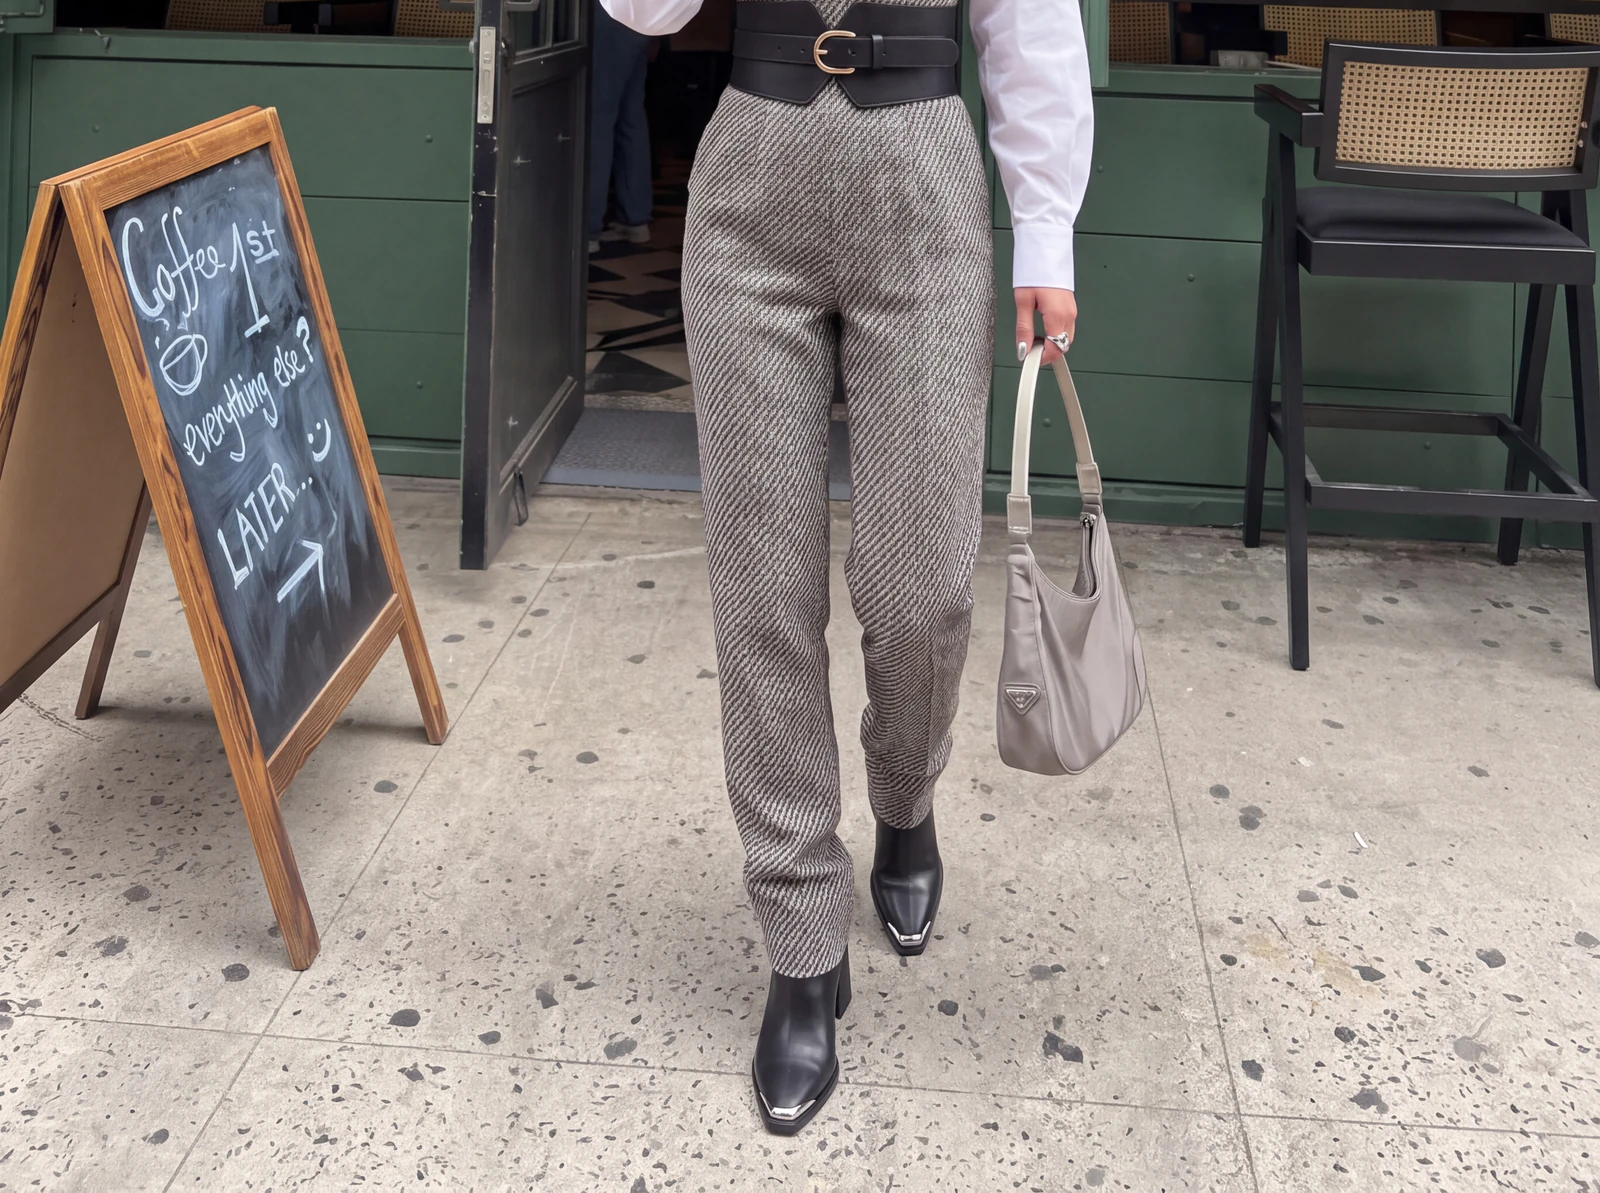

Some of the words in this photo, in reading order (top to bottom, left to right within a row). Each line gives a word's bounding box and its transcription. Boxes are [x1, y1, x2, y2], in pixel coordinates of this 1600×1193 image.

[122, 206, 226, 318] Coffee
[230, 220, 280, 339] 1st
[183, 371, 279, 467] everything
[273, 315, 314, 388] else?
